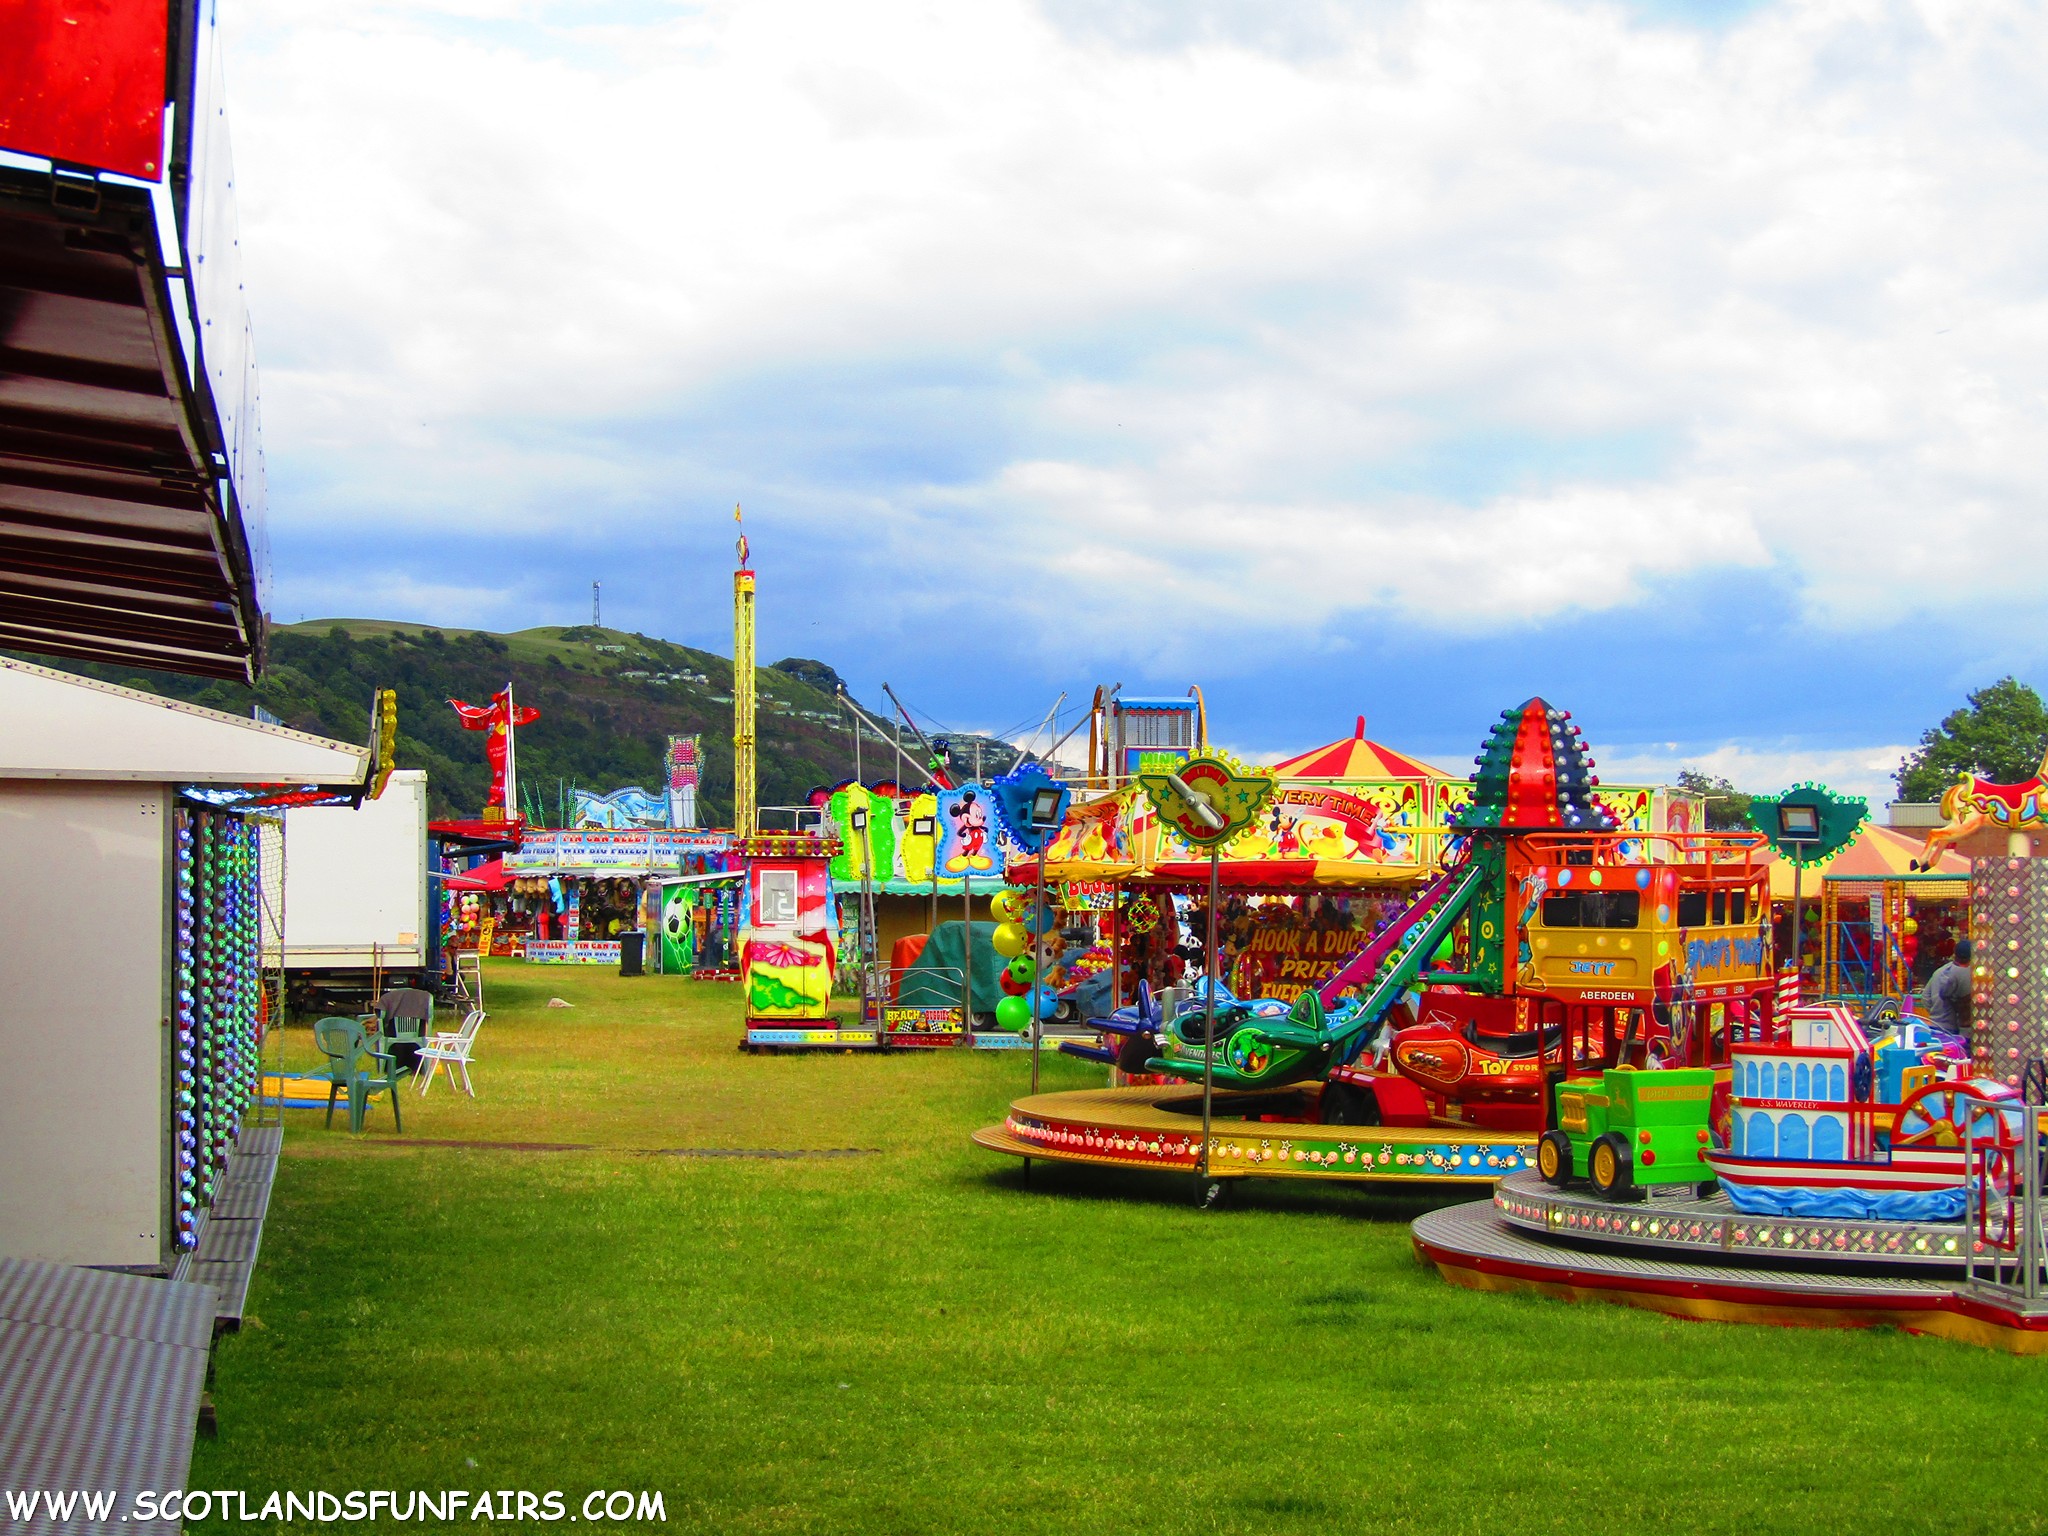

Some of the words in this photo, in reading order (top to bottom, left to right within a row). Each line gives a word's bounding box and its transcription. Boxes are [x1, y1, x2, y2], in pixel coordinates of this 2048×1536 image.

[1140, 752, 1176, 766] MINI
[1181, 765, 1229, 787] MINI
[1268, 790, 1328, 807] VERY
[1330, 796, 1377, 827] TIME
[562, 833, 583, 843] TIN
[562, 845, 585, 855] WIN
[1252, 929, 1300, 952] HOOK
[1306, 930, 1317, 953] A
[1570, 961, 1615, 975] JETT
[1580, 991, 1635, 1001] ABERDEEN
[887, 1009, 920, 1020] BEACH
[1479, 1059, 1512, 1075] TOY
[1776, 1101, 1819, 1110] WAVERLEY.
